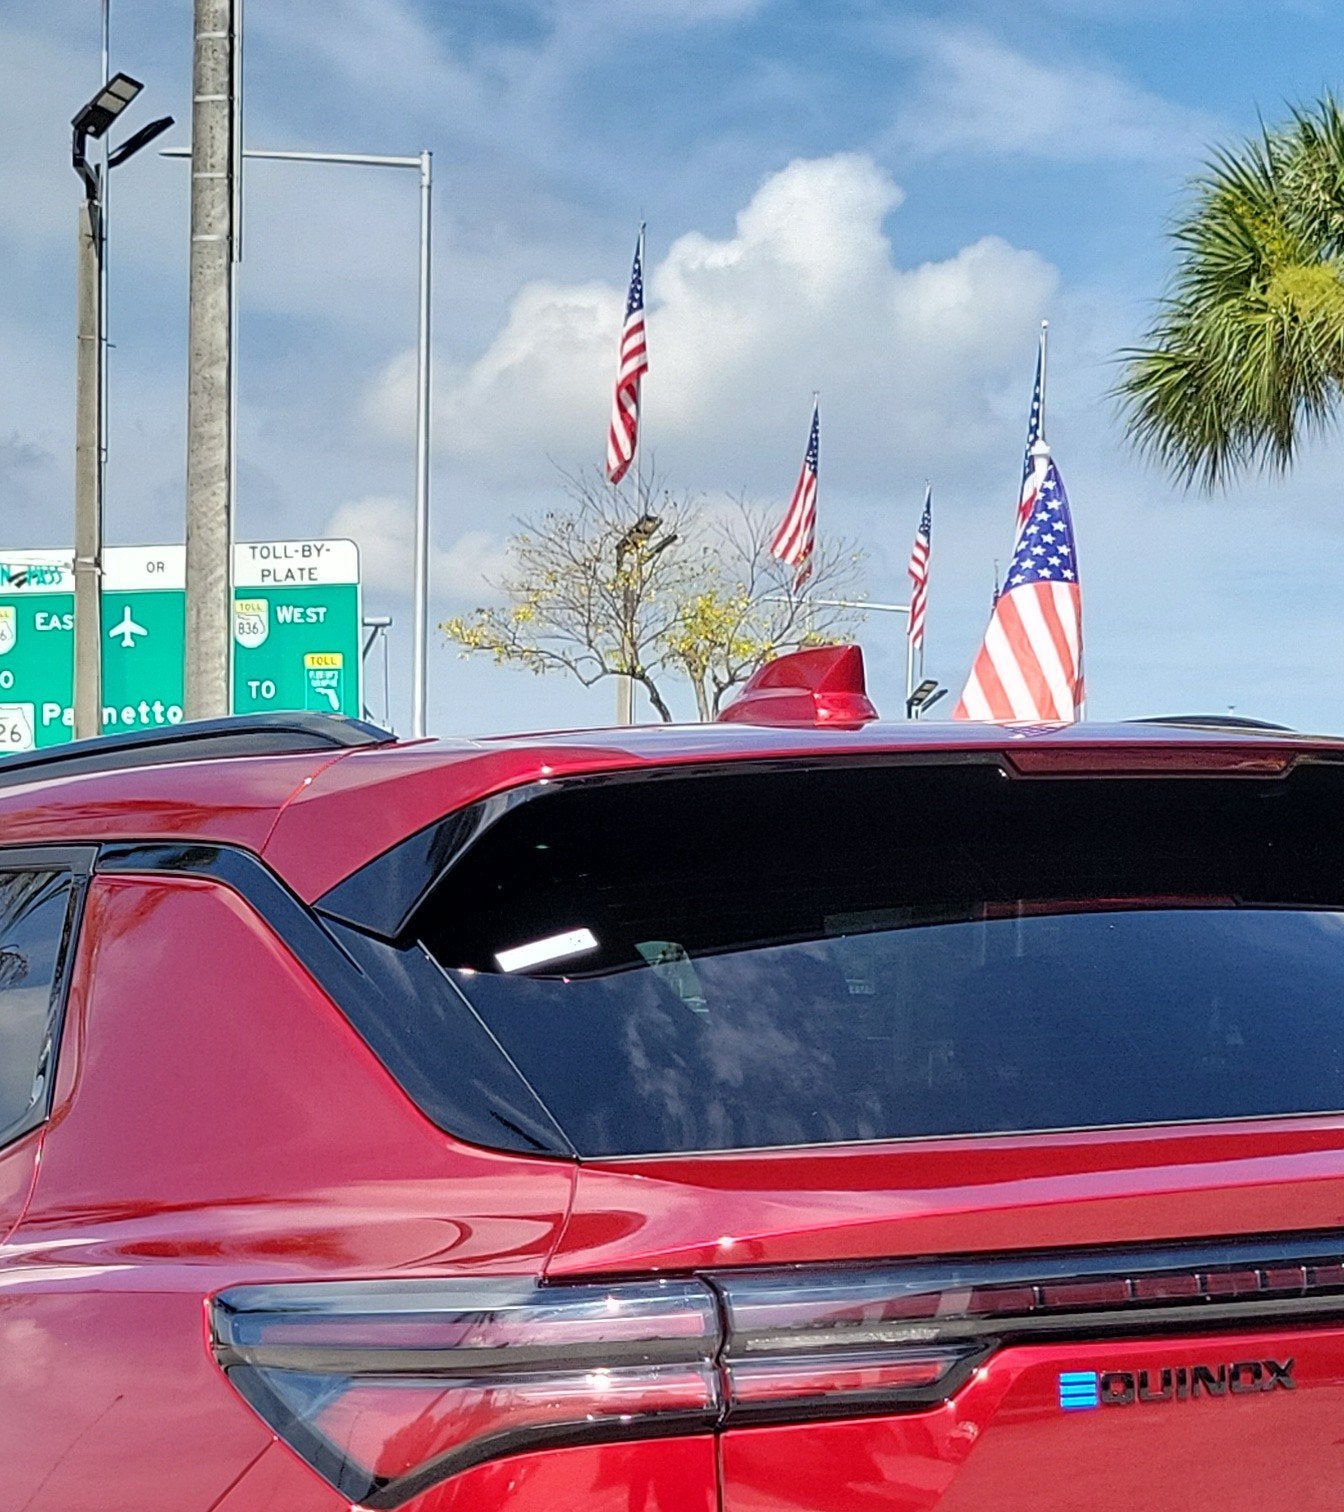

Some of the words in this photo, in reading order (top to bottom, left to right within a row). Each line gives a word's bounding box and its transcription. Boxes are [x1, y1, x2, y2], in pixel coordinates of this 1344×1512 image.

[249, 544, 331, 560] TOLL-BY-
[146, 561, 165, 573] OR
[261, 567, 318, 582] PLATE
[239, 603, 263, 611] TOLL
[276, 605, 327, 624] WEST
[35, 612, 75, 631] EAS
[238, 622, 259, 635] 836
[310, 656, 337, 665] TOLL
[248, 680, 276, 699] TO
[42, 700, 183, 726] Pametto
[1059, 1358, 1297, 1410] EQUINOX
